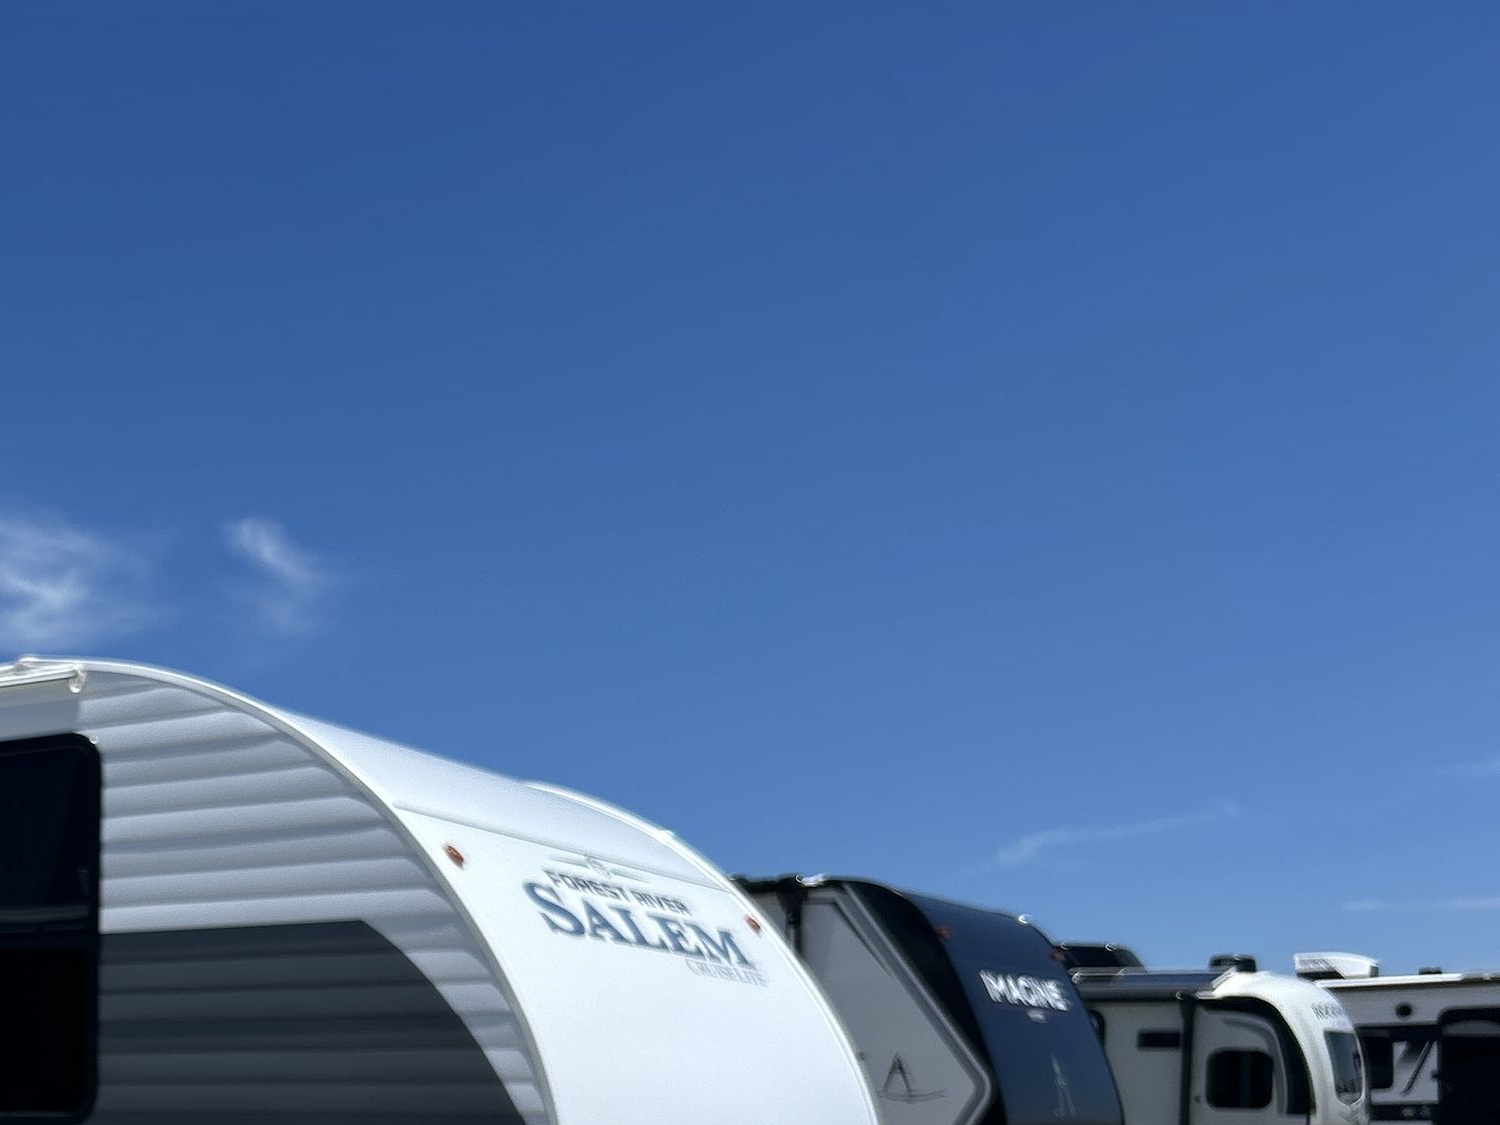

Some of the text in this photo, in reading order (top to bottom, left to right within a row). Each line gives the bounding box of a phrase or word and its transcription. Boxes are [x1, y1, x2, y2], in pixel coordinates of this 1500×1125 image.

[521, 879, 757, 970] SALEM
[543, 869, 692, 916] FOREST RIVER
